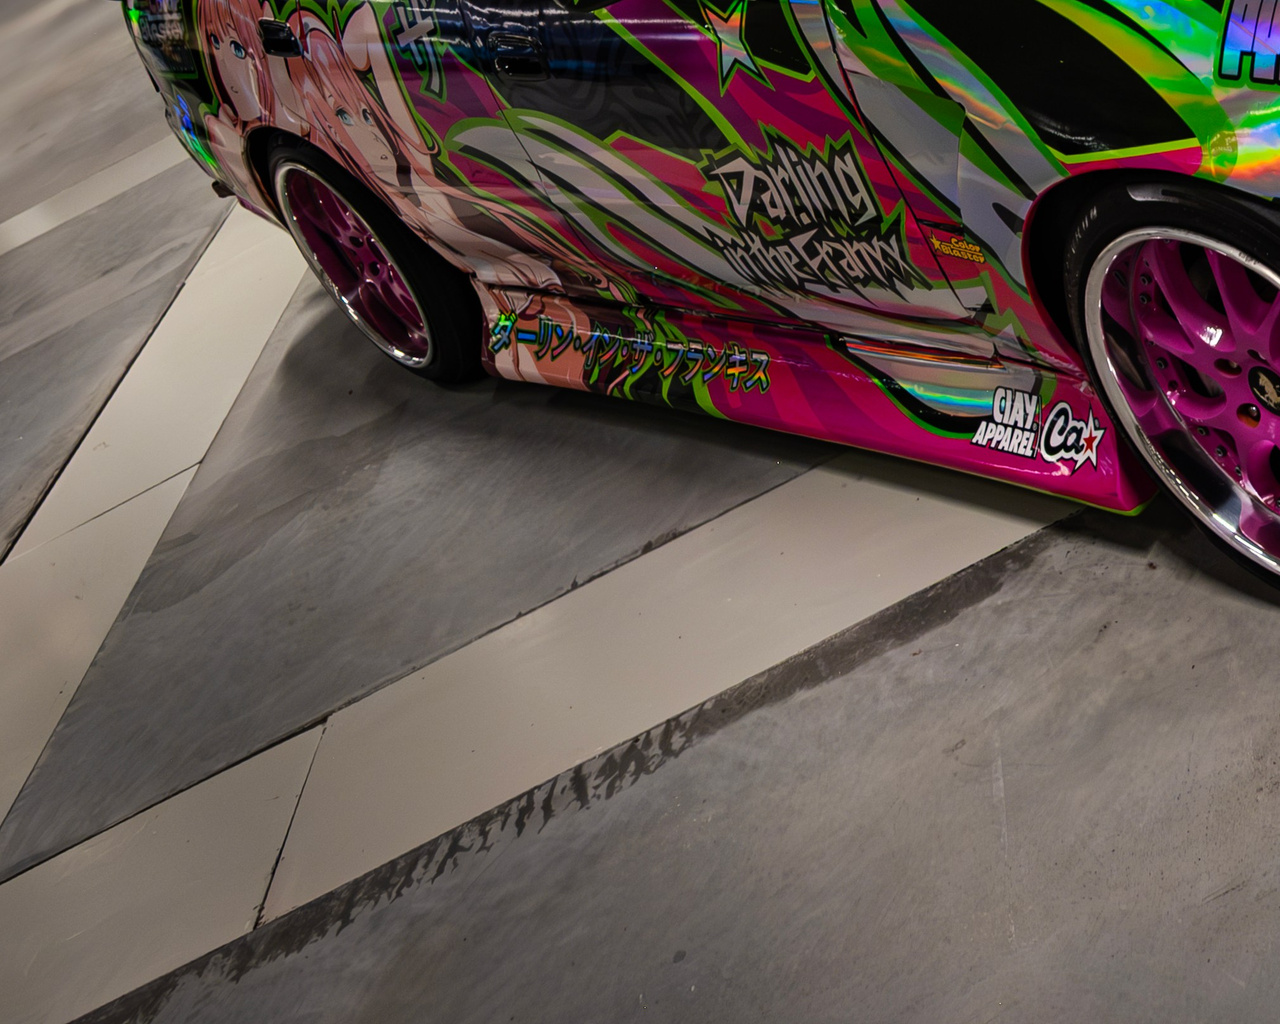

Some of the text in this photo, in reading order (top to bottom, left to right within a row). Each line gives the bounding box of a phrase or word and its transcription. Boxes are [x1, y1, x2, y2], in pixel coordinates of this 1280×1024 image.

[708, 142, 879, 227] Darling
[488, 311, 772, 394] ダーリン・イン・ザ・フランキス
[970, 420, 1036, 458] APPAREL
